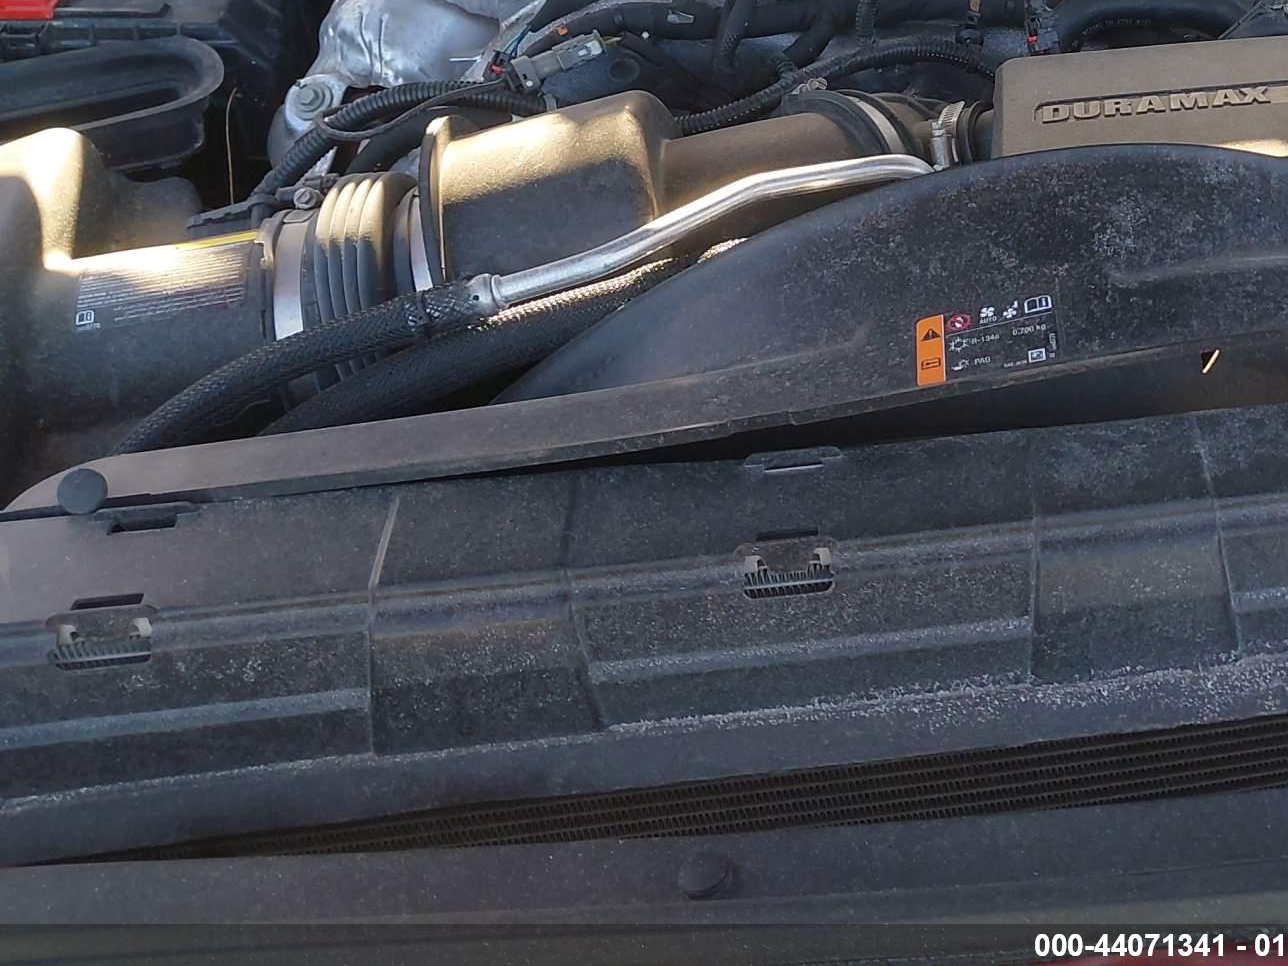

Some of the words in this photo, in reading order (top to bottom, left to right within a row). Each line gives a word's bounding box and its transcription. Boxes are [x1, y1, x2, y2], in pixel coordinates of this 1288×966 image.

[1041, 88, 1271, 124] DURAMAX
[979, 316, 997, 324] AUTO
[971, 334, 1000, 345] R-134a
[974, 356, 991, 365] PAG
